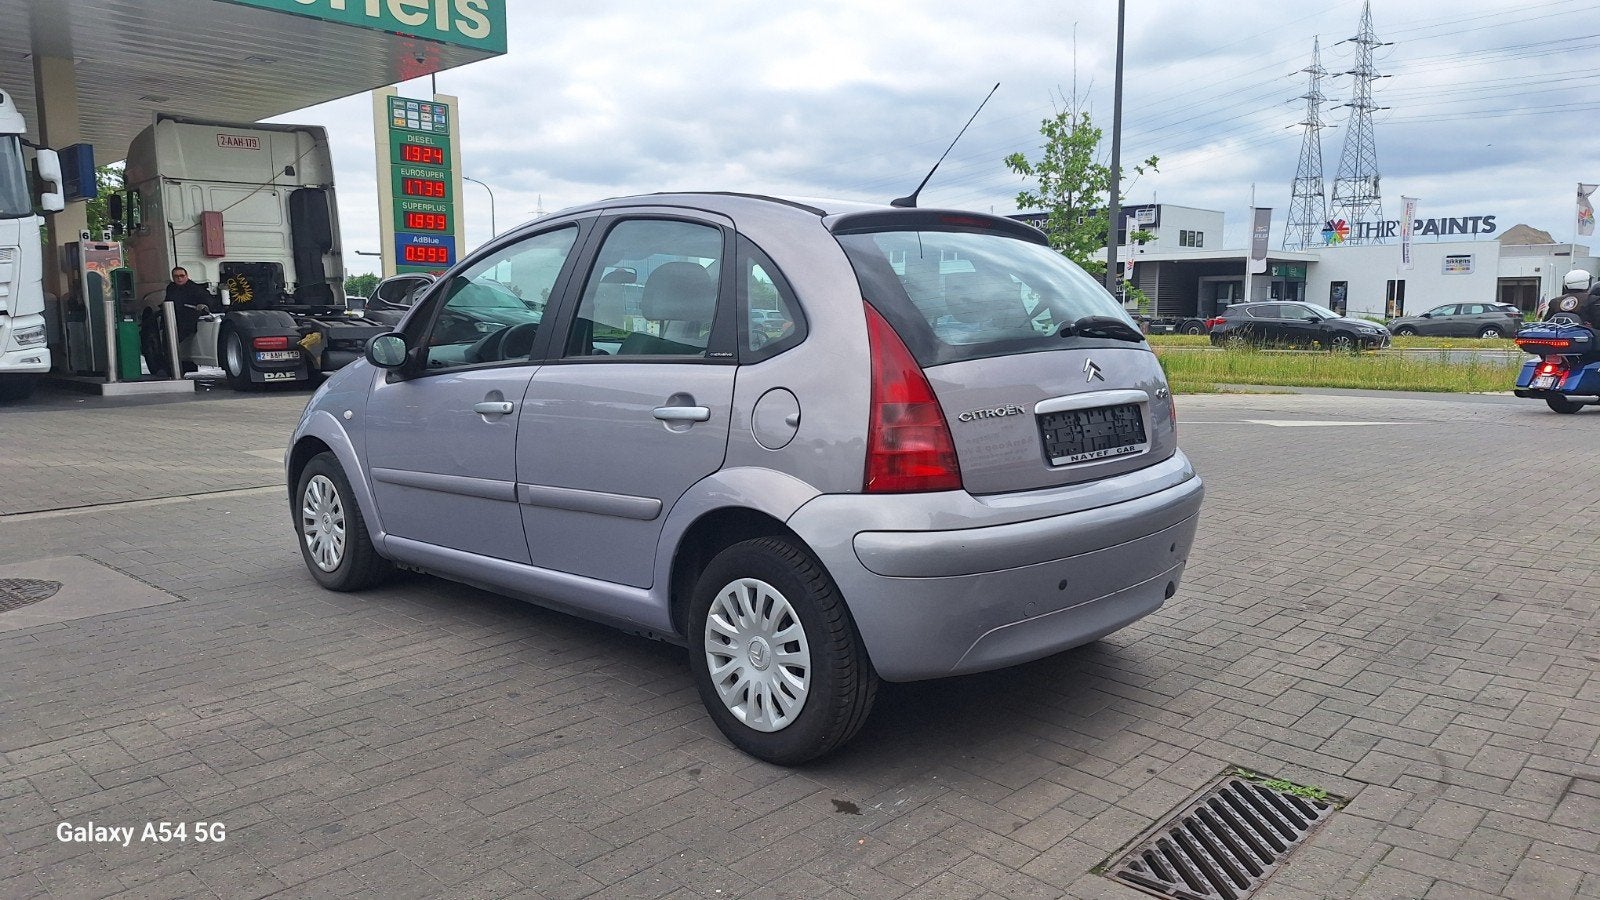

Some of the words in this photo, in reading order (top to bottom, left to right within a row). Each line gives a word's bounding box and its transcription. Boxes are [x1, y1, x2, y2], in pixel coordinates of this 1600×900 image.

[407, 134, 435, 145] DIESEL
[405, 145, 443, 164] 1.924
[400, 167, 445, 179] EUROSUPER
[402, 201, 447, 212] SUPERPLUS
[408, 213, 446, 229] 1.899
[1413, 215, 1497, 235] PAINTS
[82, 232, 89, 240] 6
[104, 232, 111, 240] 5
[412, 235, 440, 245] AdBlue
[264, 371, 296, 379] DAF
[958, 404, 1026, 422] CITROËN
[1070, 449, 1110, 462] NAYEF
[1116, 445, 1136, 455] CAR
